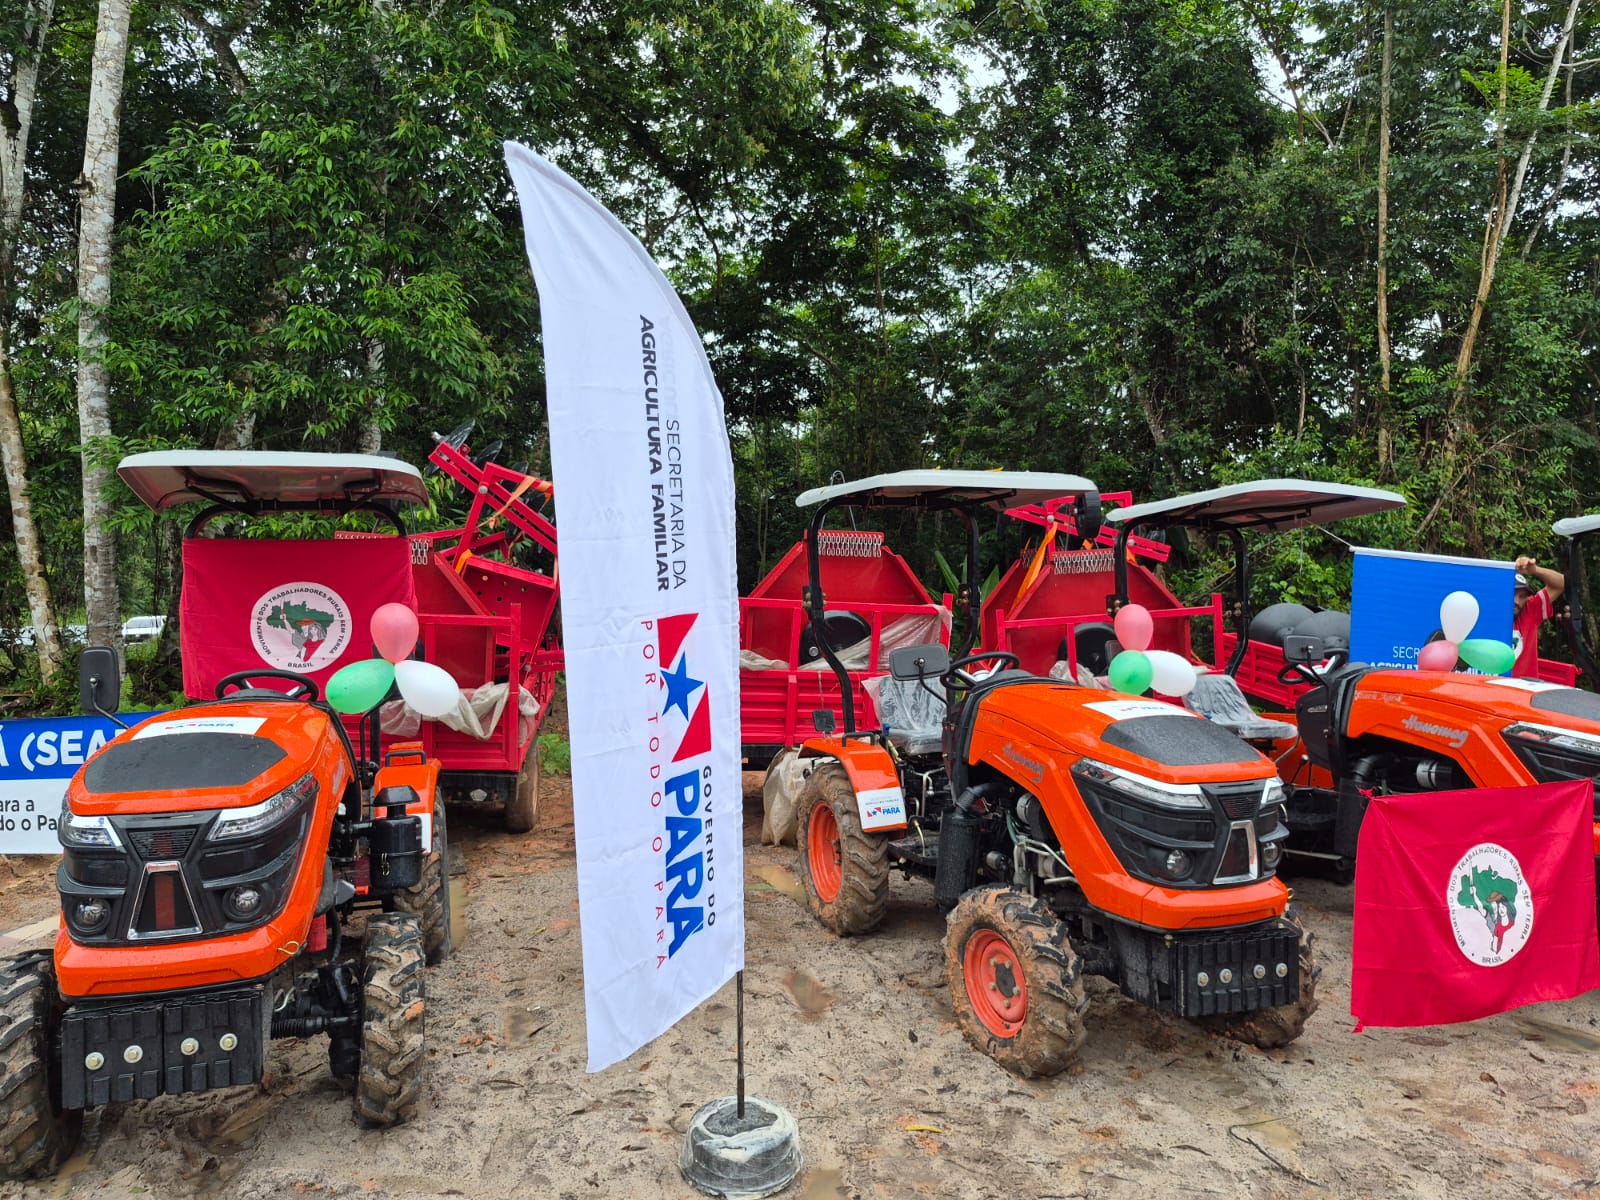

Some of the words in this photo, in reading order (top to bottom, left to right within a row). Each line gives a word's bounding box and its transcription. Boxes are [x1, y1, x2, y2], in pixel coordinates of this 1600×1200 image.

[640, 314, 662, 475] AGRICULTURA
[651, 484, 669, 592] FAMILIAR
[666, 419, 685, 554] SECRETARIA
[672, 560, 687, 590] DA
[258, 603, 269, 616] DOS
[268, 587, 327, 603] TRABALHADORES
[327, 596, 345, 619] RURAIS
[256, 616, 272, 655] MOVIMENTO
[328, 632, 345, 654] TERRA
[640, 620, 657, 685] POR
[1393, 646, 1423, 659] SECR
[20, 729, 127, 772] (SEA
[647, 712, 662, 808] TODO
[26, 799, 35, 812] a
[21, 818, 32, 831] o
[703, 765, 714, 882] GOVERNO
[652, 836, 663, 853] O
[664, 769, 704, 960] PARÁ
[1449, 874, 1458, 892] DOS
[707, 894, 716, 927] DO
[1449, 897, 1466, 948] MOVIMENTO
[1520, 913, 1532, 941] TERRA
